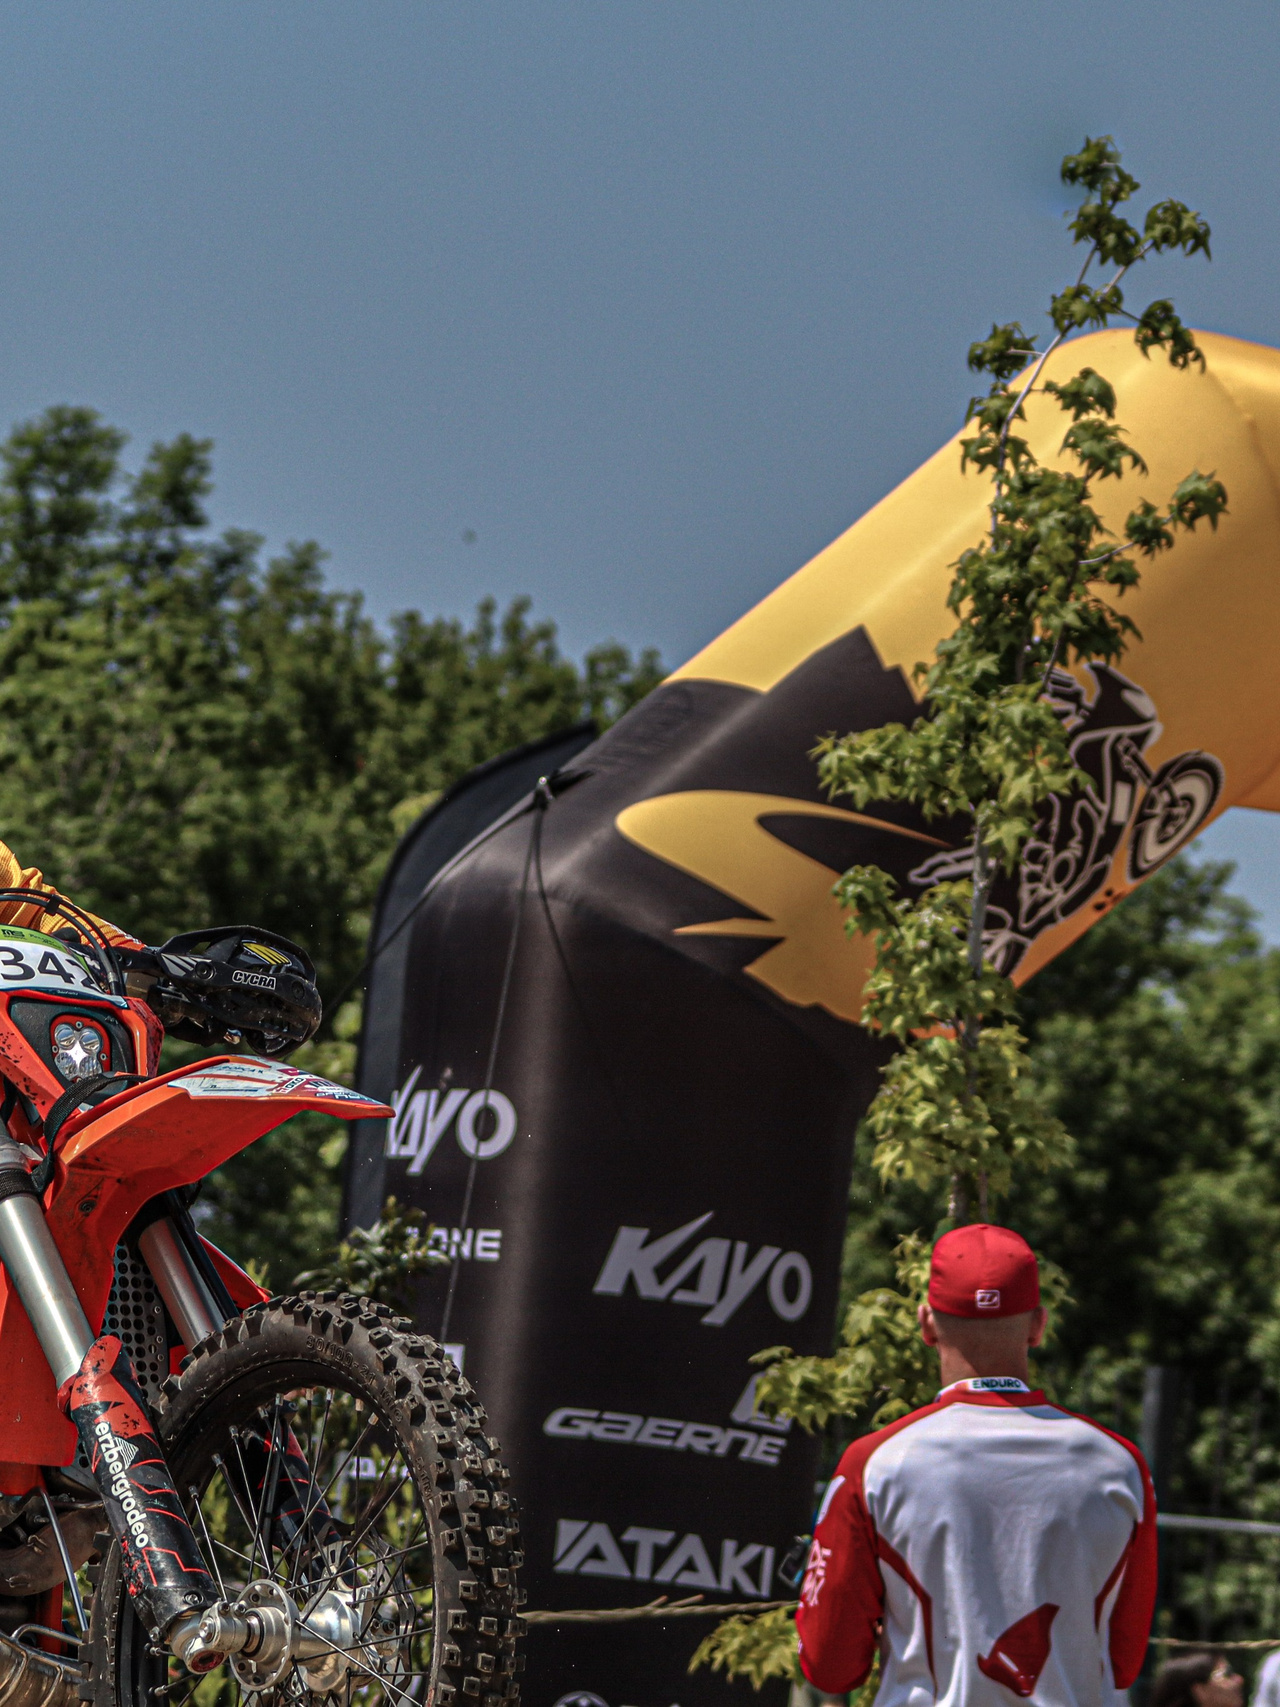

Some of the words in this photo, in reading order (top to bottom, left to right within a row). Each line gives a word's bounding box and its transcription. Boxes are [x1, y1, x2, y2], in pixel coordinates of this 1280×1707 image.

[232, 970, 276, 990] CYCRA
[593, 1211, 812, 1327] KAYO
[972, 1379, 1021, 1389] ENDURO
[95, 1421, 149, 1548] erzbergrodeo
[553, 1518, 775, 1599] ATAKI
